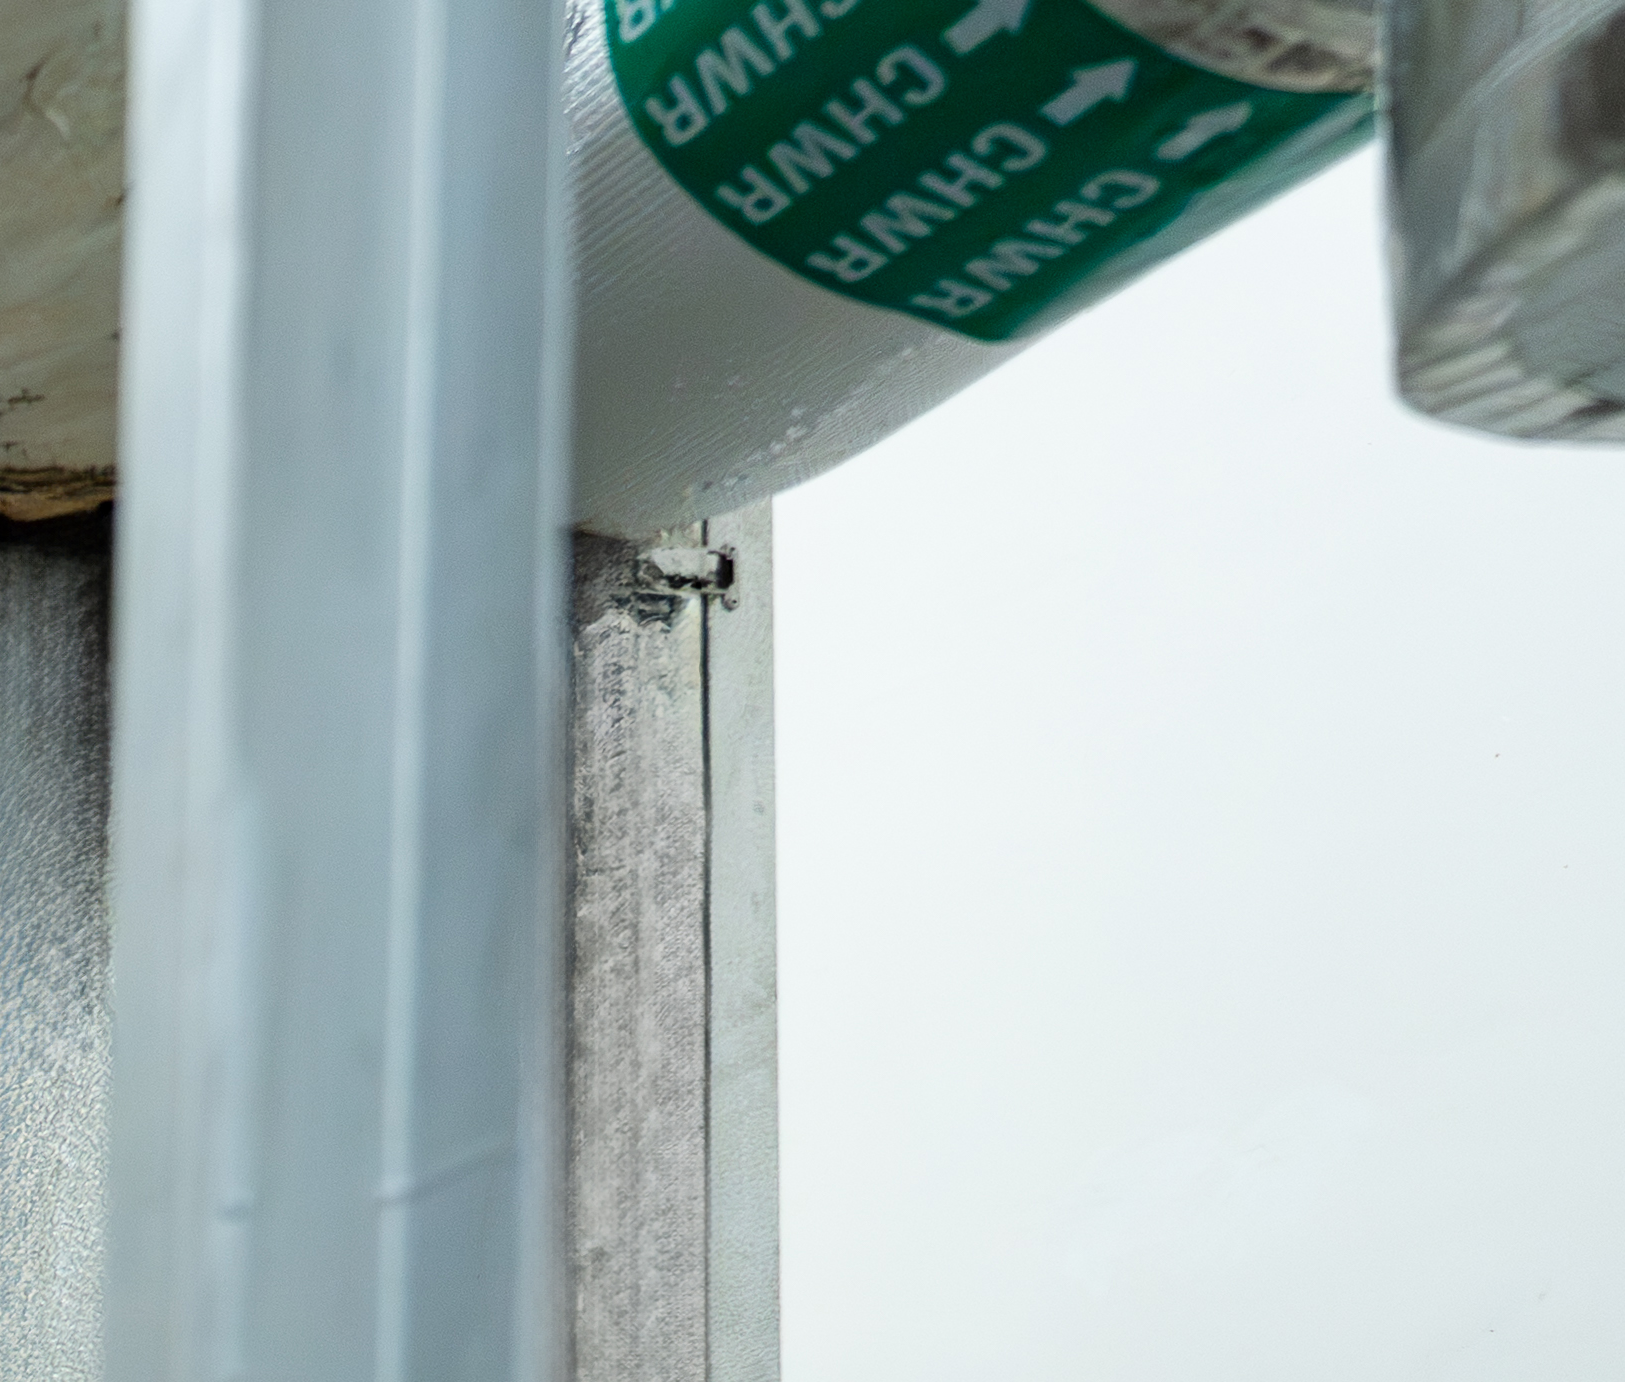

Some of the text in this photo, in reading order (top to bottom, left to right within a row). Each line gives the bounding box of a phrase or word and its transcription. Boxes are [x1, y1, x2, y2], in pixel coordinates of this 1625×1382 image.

[716, 44, 947, 226] CHWR
[806, 121, 1049, 284] CHWR
[912, 169, 1162, 318] CHWR
